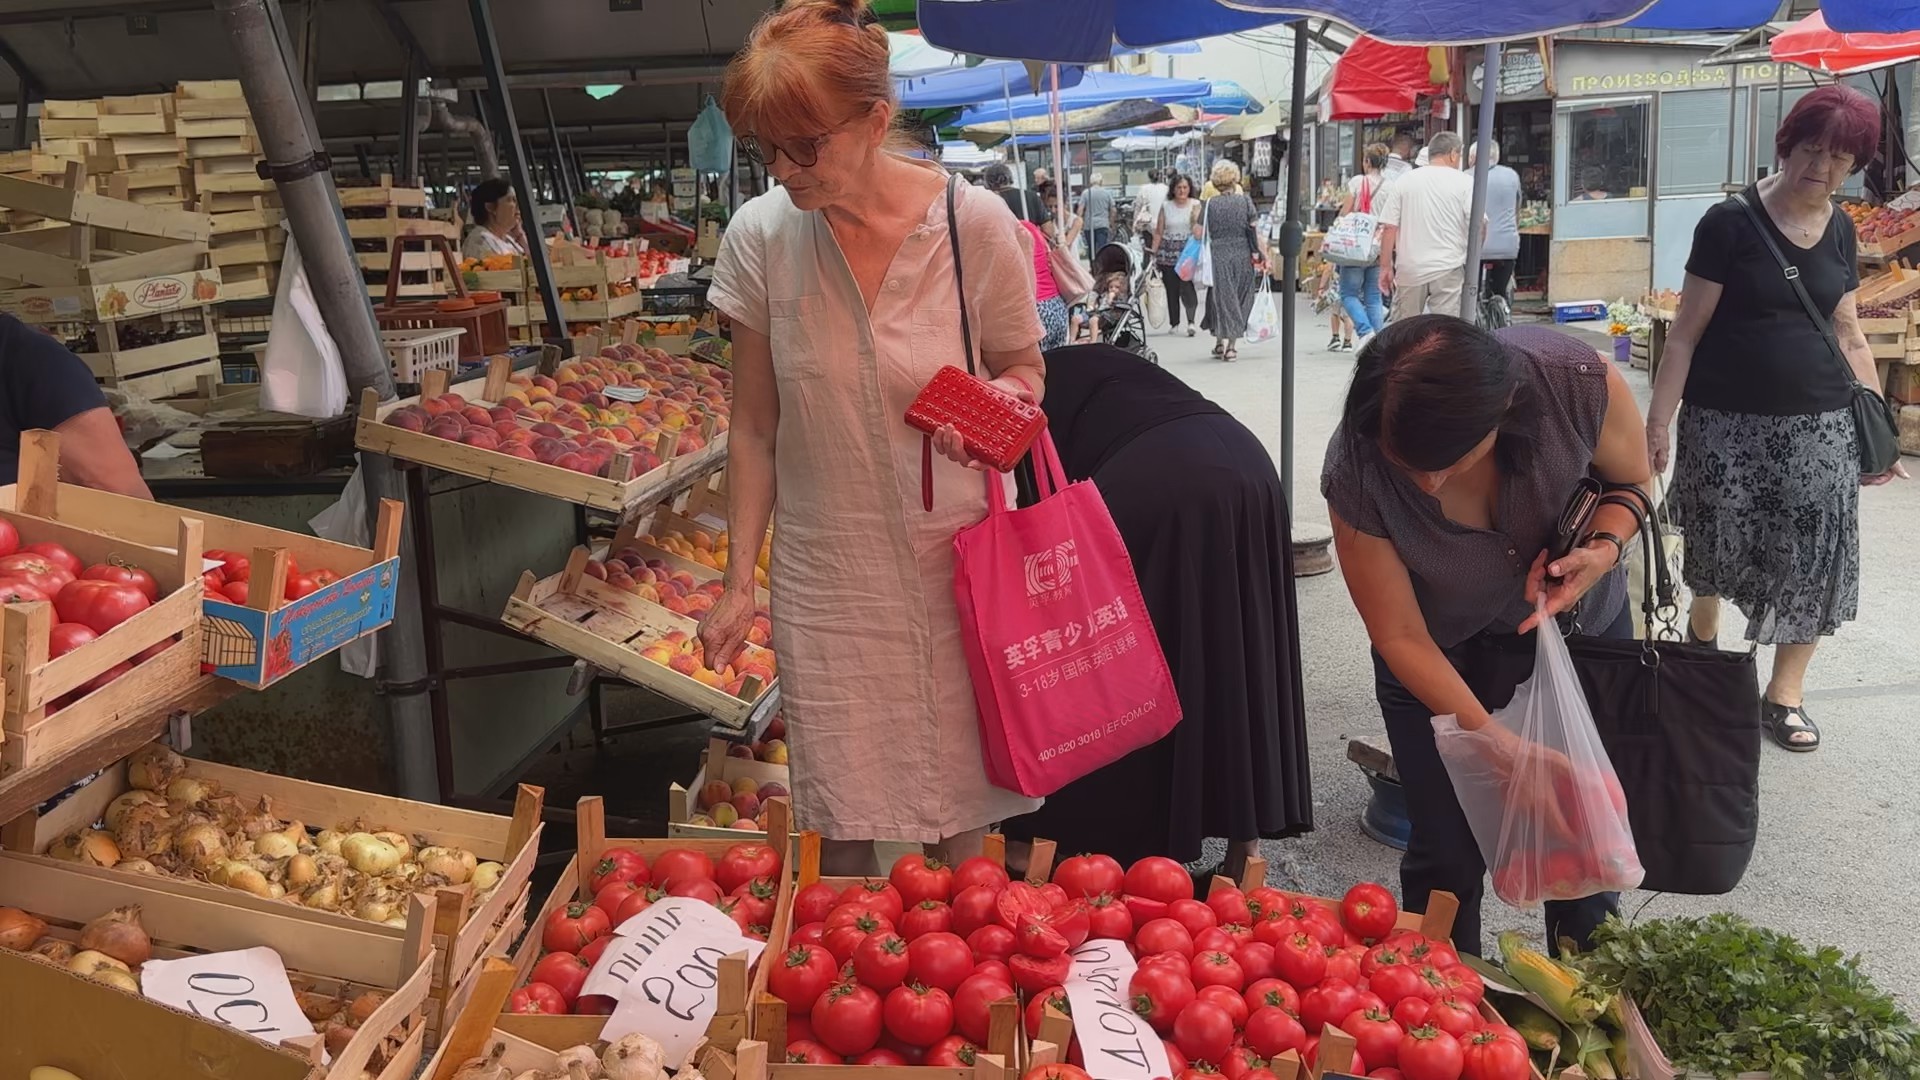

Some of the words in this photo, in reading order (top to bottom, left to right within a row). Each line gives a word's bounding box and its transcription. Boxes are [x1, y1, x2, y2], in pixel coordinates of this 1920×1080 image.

[1038, 746, 1056, 762] 400
[1058, 740, 1076, 754] 820
[1077, 729, 1101, 747] 3018
